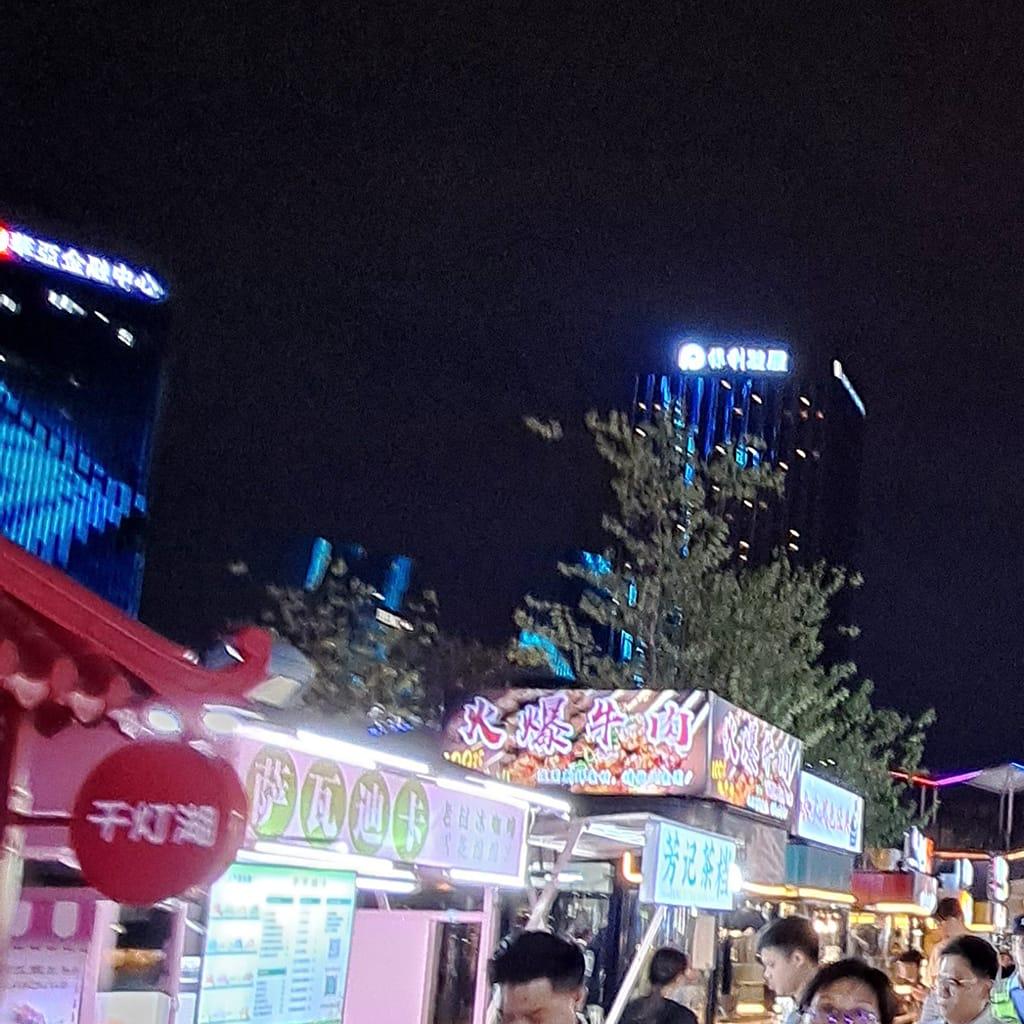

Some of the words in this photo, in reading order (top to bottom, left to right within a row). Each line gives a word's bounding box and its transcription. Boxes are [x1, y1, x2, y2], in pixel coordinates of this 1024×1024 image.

[458, 694, 696, 755] 火爆牛肉
[86, 800, 217, 847] 千灯湖
[251, 758, 426, 851] 萨瓦迪卡
